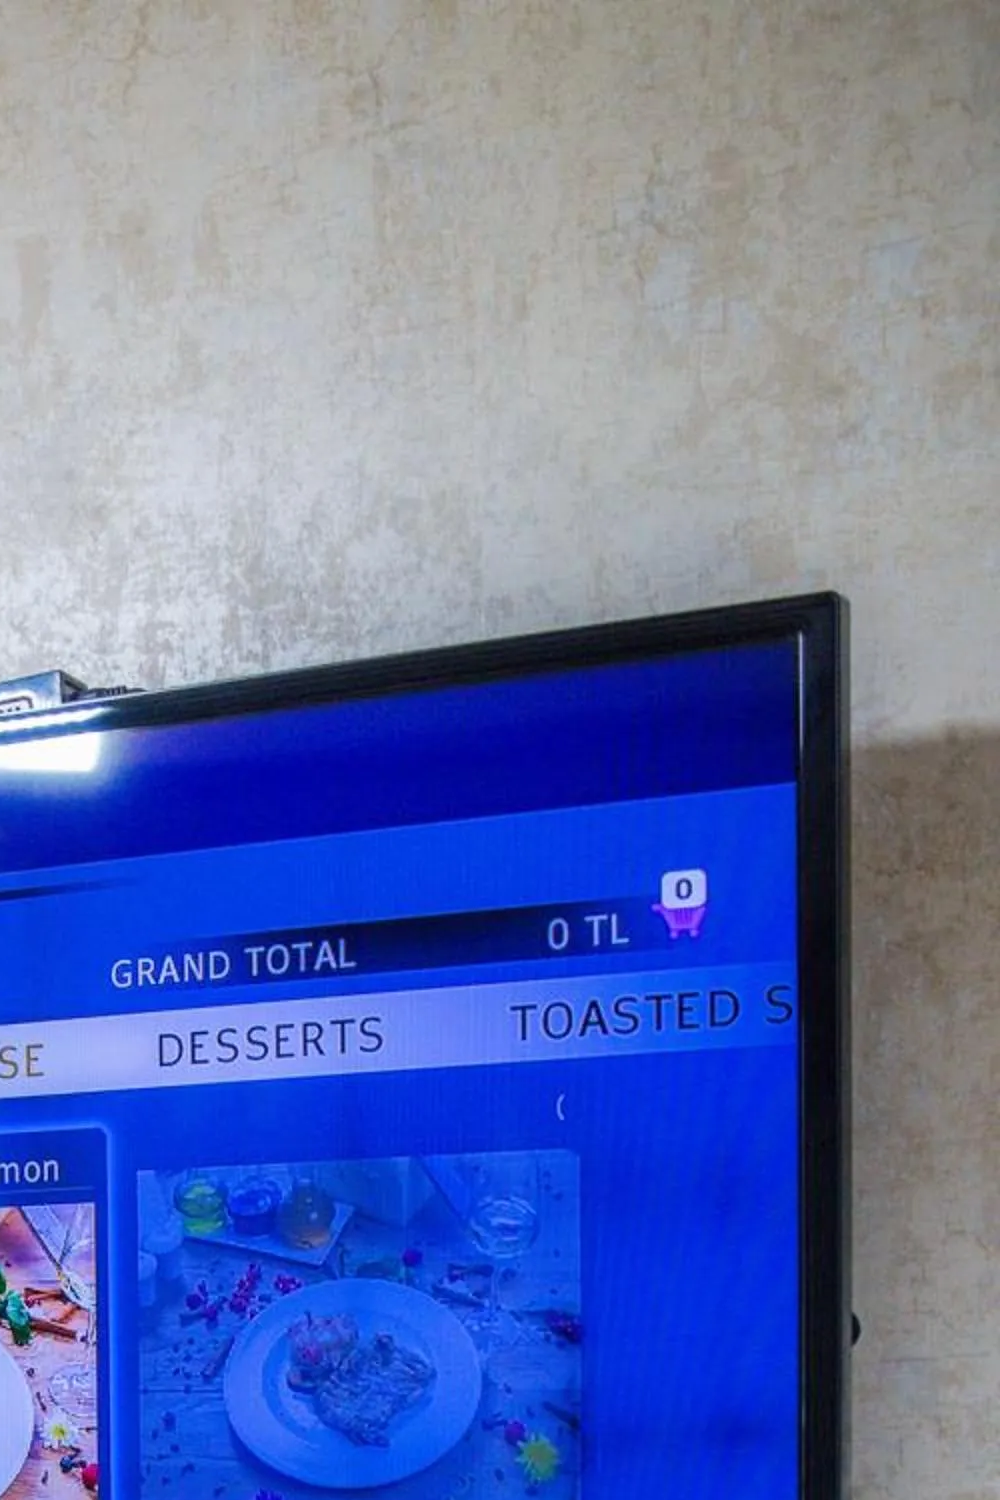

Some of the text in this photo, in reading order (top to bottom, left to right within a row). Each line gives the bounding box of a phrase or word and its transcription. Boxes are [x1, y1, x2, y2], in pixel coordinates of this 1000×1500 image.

[675, 878, 693, 900] 0
[547, 914, 630, 950] 0 TL
[111, 938, 357, 988] GRAND TOTAL
[510, 989, 741, 1041] TOASTED
[158, 1016, 384, 1067] DESSERTS
